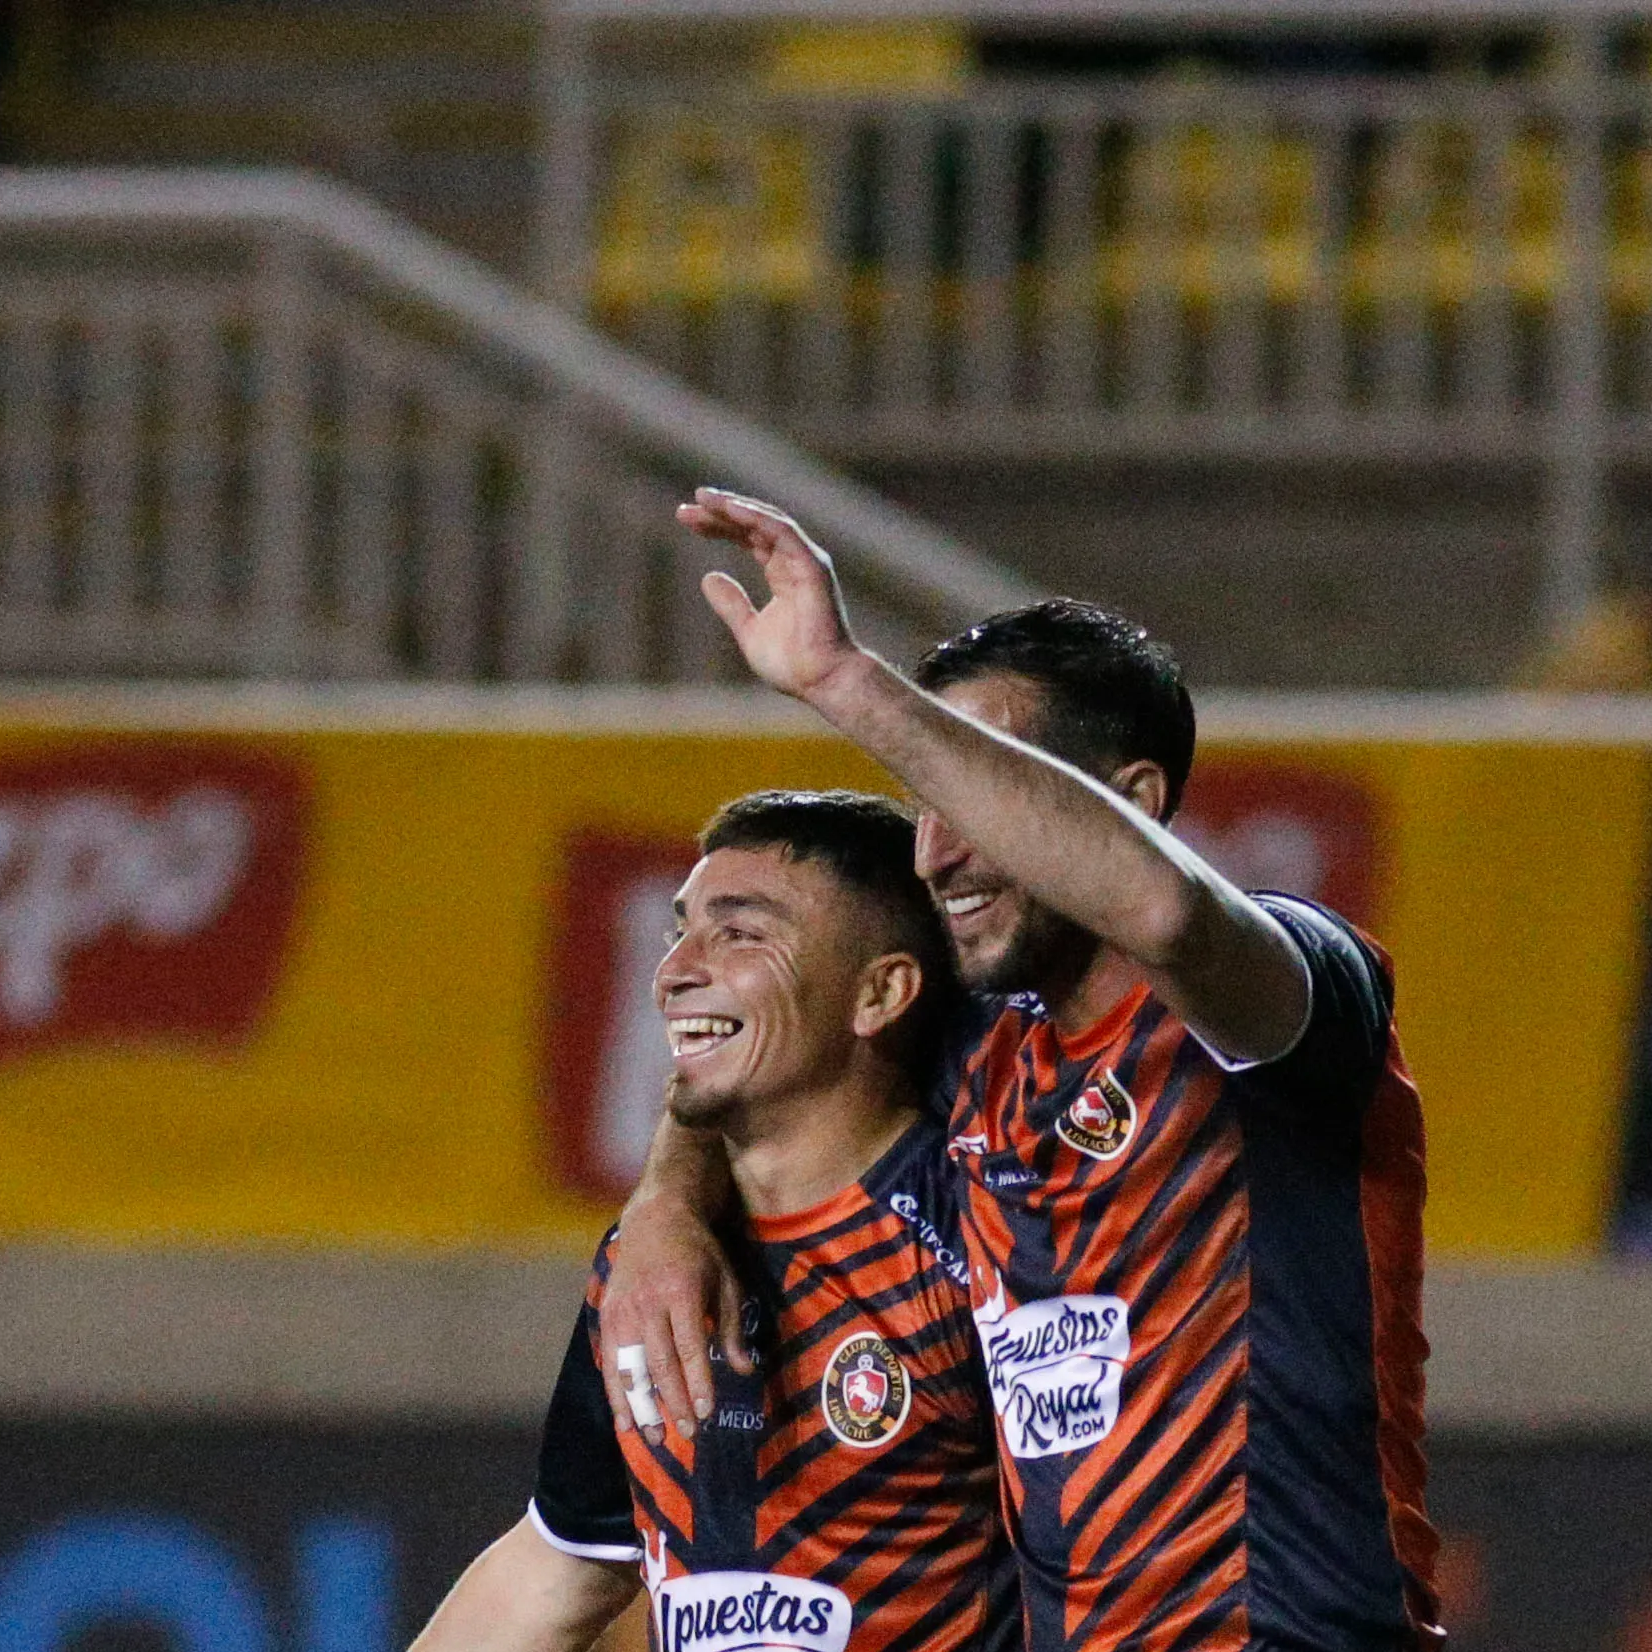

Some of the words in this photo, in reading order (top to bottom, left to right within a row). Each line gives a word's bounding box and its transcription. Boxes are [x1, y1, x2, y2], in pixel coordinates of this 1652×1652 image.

[839, 1341, 869, 1363] CLUB
[871, 1341, 904, 1401] DEPORTES
[717, 1408, 765, 1432] MEDS
[827, 1398, 873, 1441] LIMACHE
[1016, 1363, 1108, 1450] Royal
[1069, 1416, 1106, 1441] .COM
